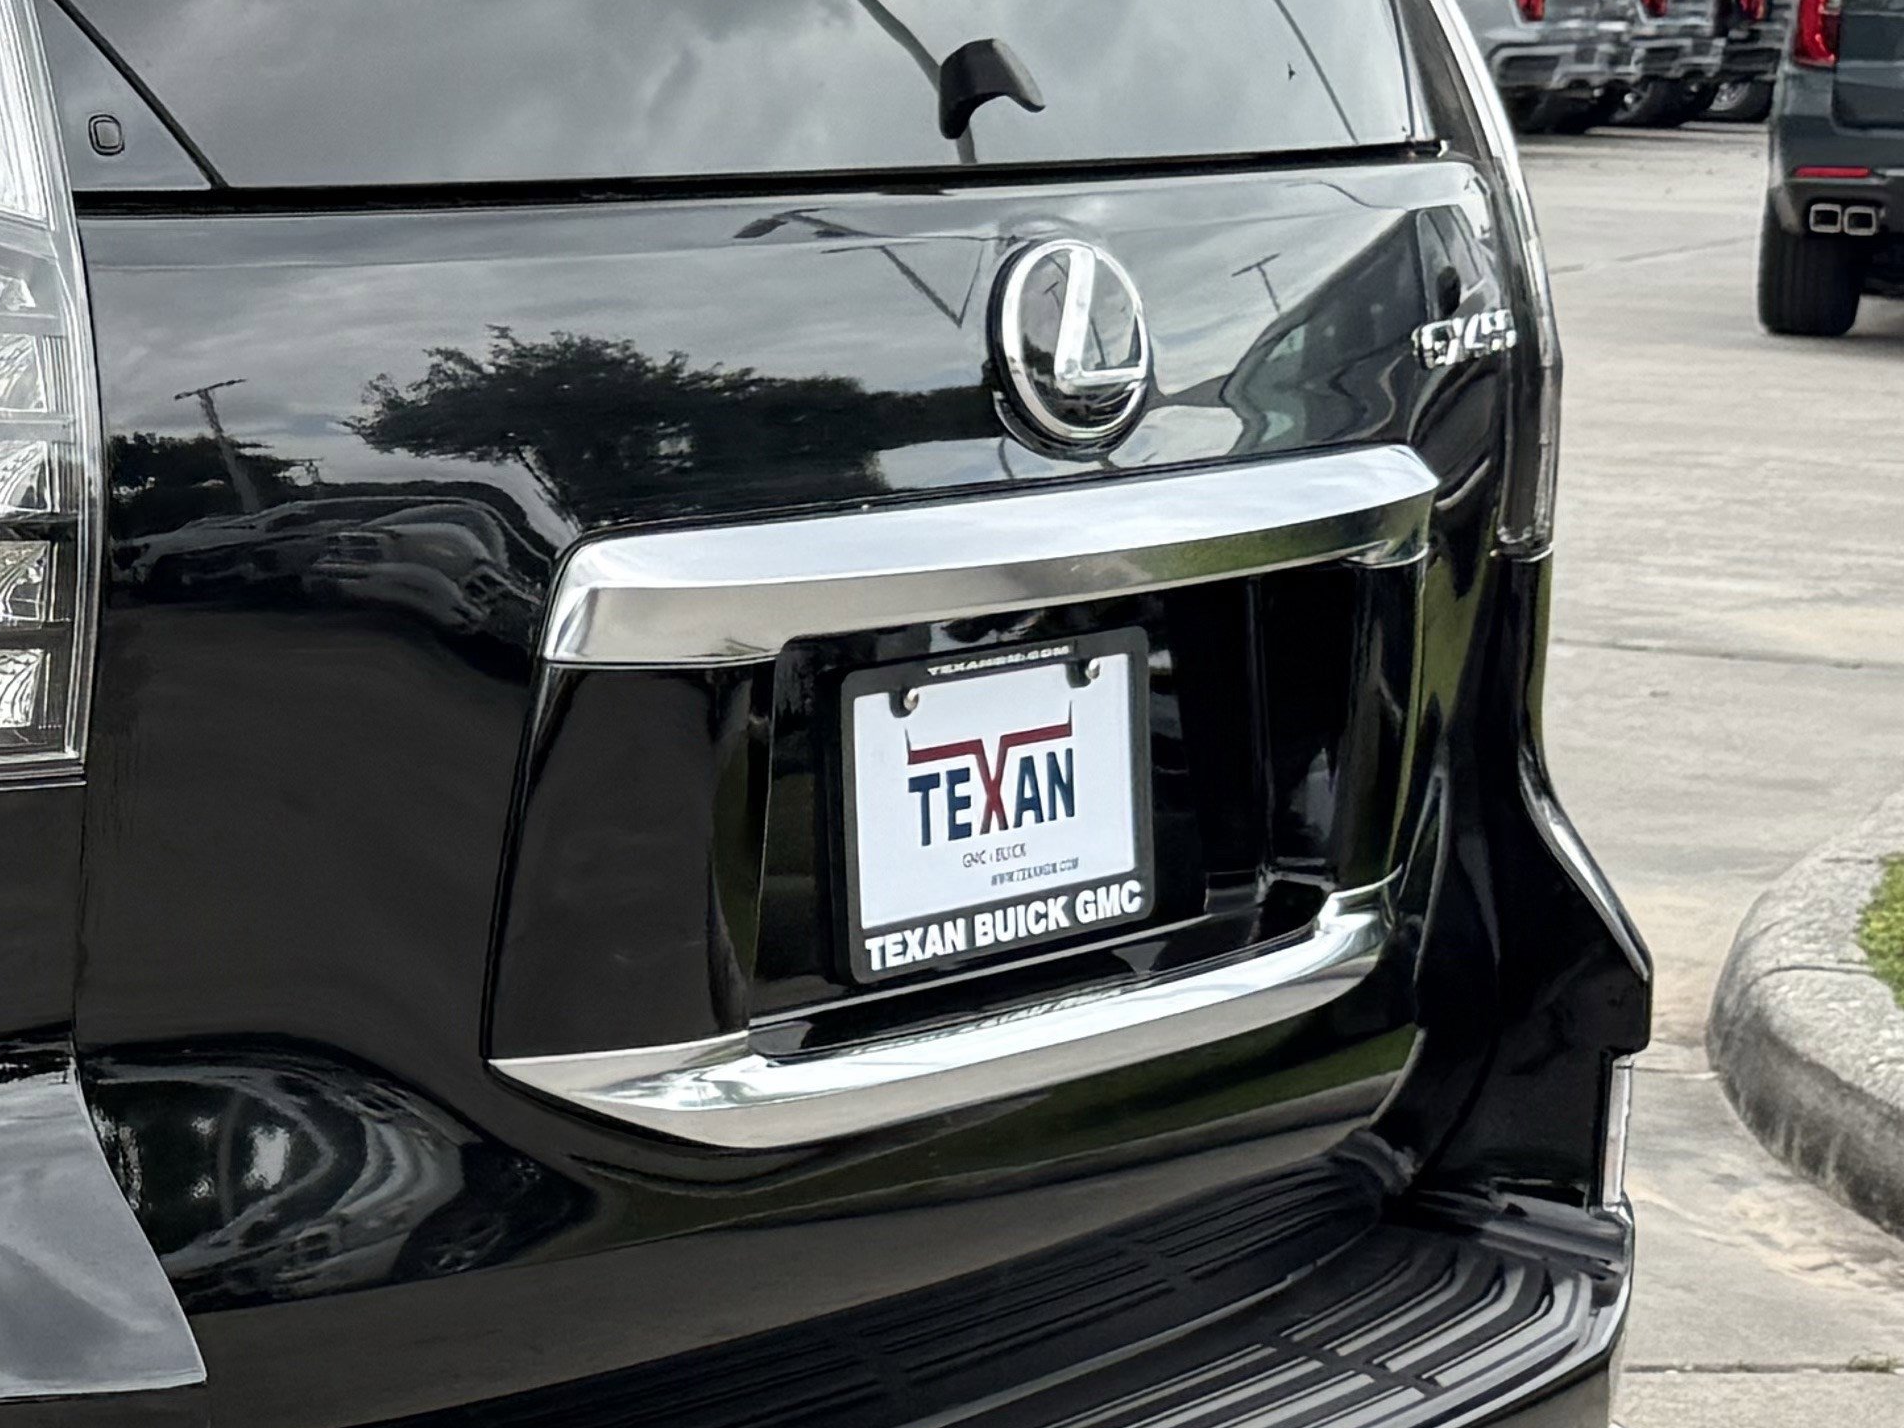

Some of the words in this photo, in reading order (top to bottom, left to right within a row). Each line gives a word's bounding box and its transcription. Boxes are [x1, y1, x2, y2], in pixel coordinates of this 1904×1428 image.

[906, 722, 1076, 847] TEXAN
[864, 918, 967, 972] TEXAN
[973, 895, 1070, 946] BUICK
[1074, 878, 1143, 927] GMC
